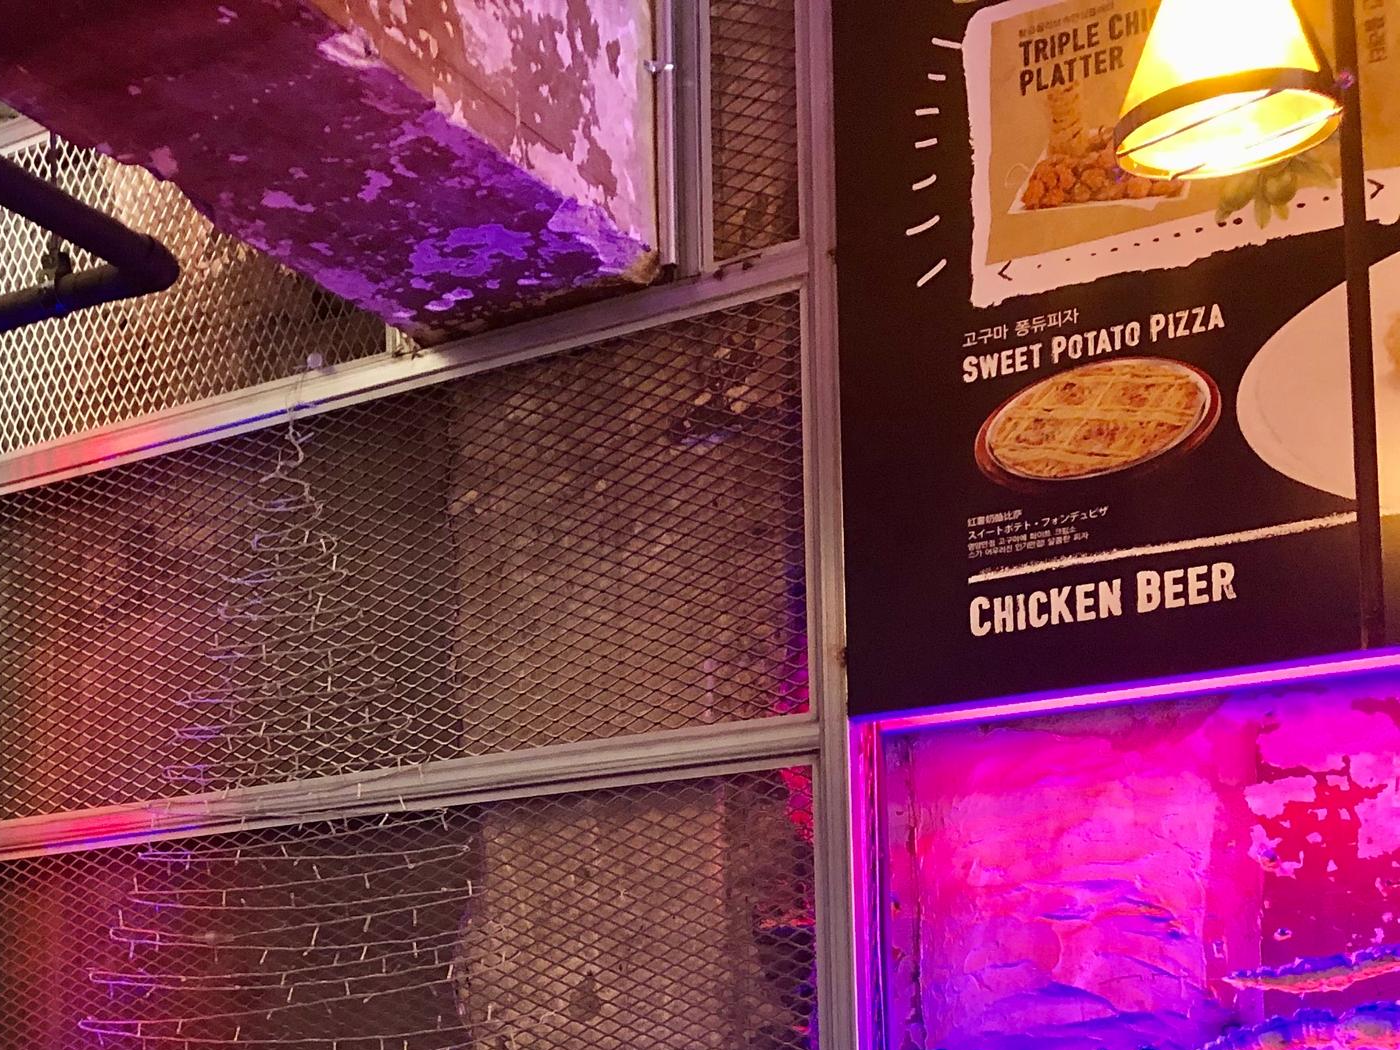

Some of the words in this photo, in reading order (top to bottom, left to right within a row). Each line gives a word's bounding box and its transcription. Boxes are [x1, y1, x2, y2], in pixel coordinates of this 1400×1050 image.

[1018, 22, 1100, 67] TRIPLE
[1019, 45, 1125, 97] PLATTER
[962, 327, 1009, 347] 고구마
[1014, 308, 1080, 337] 퐁듀피자
[962, 343, 1043, 384] SWEET
[1051, 321, 1141, 364] POTATO
[1149, 303, 1226, 342] PIZZA
[969, 577, 1122, 638] CHICKEN
[1136, 562, 1237, 614] BEER
